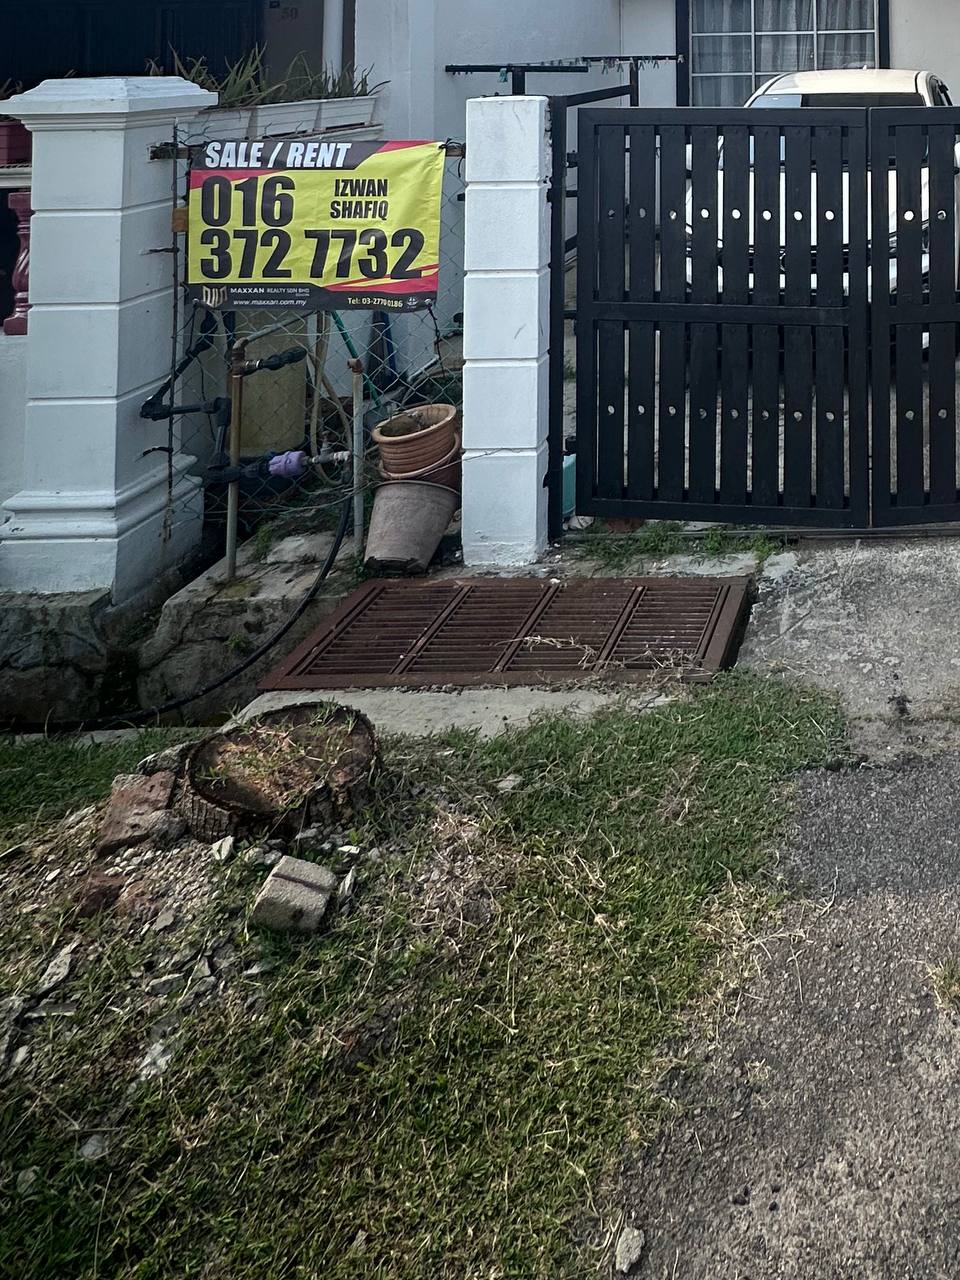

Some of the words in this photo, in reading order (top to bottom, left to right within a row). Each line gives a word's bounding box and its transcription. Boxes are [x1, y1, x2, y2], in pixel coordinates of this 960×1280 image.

[205, 142, 262, 168] SALE
[267, 141, 280, 168] /
[286, 142, 352, 168] RENT
[334, 179, 388, 197] IZWAN
[201, 175, 295, 228] 016
[330, 200, 388, 221] SHAFIQ
[200, 228, 293, 279] 372
[304, 228, 425, 280] 7732
[348, 297, 360, 305] Tel:
